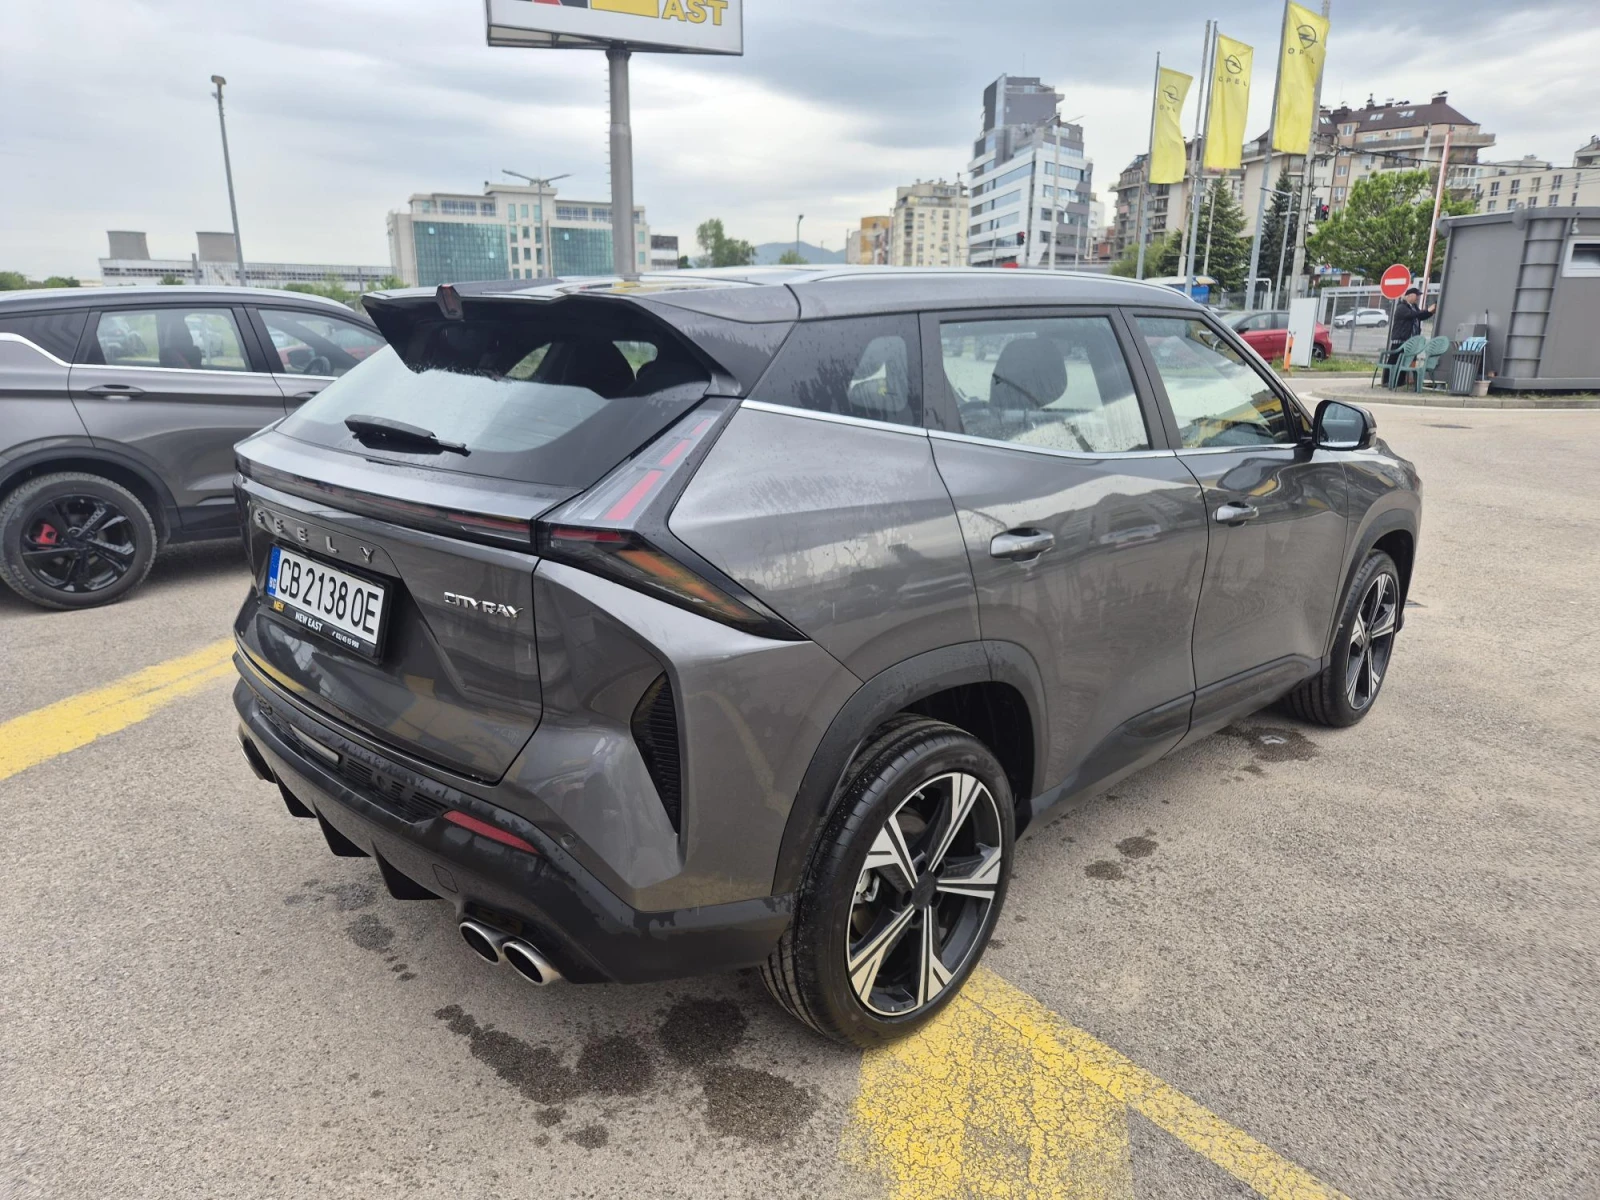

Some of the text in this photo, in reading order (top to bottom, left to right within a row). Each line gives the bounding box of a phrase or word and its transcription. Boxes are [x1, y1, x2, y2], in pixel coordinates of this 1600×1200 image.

[1218, 76, 1247, 87] OPEL
[279, 558, 379, 635] CB 2138 OE
[443, 591, 524, 618] CITYRAY
[295, 611, 323, 631] NEW EAST
